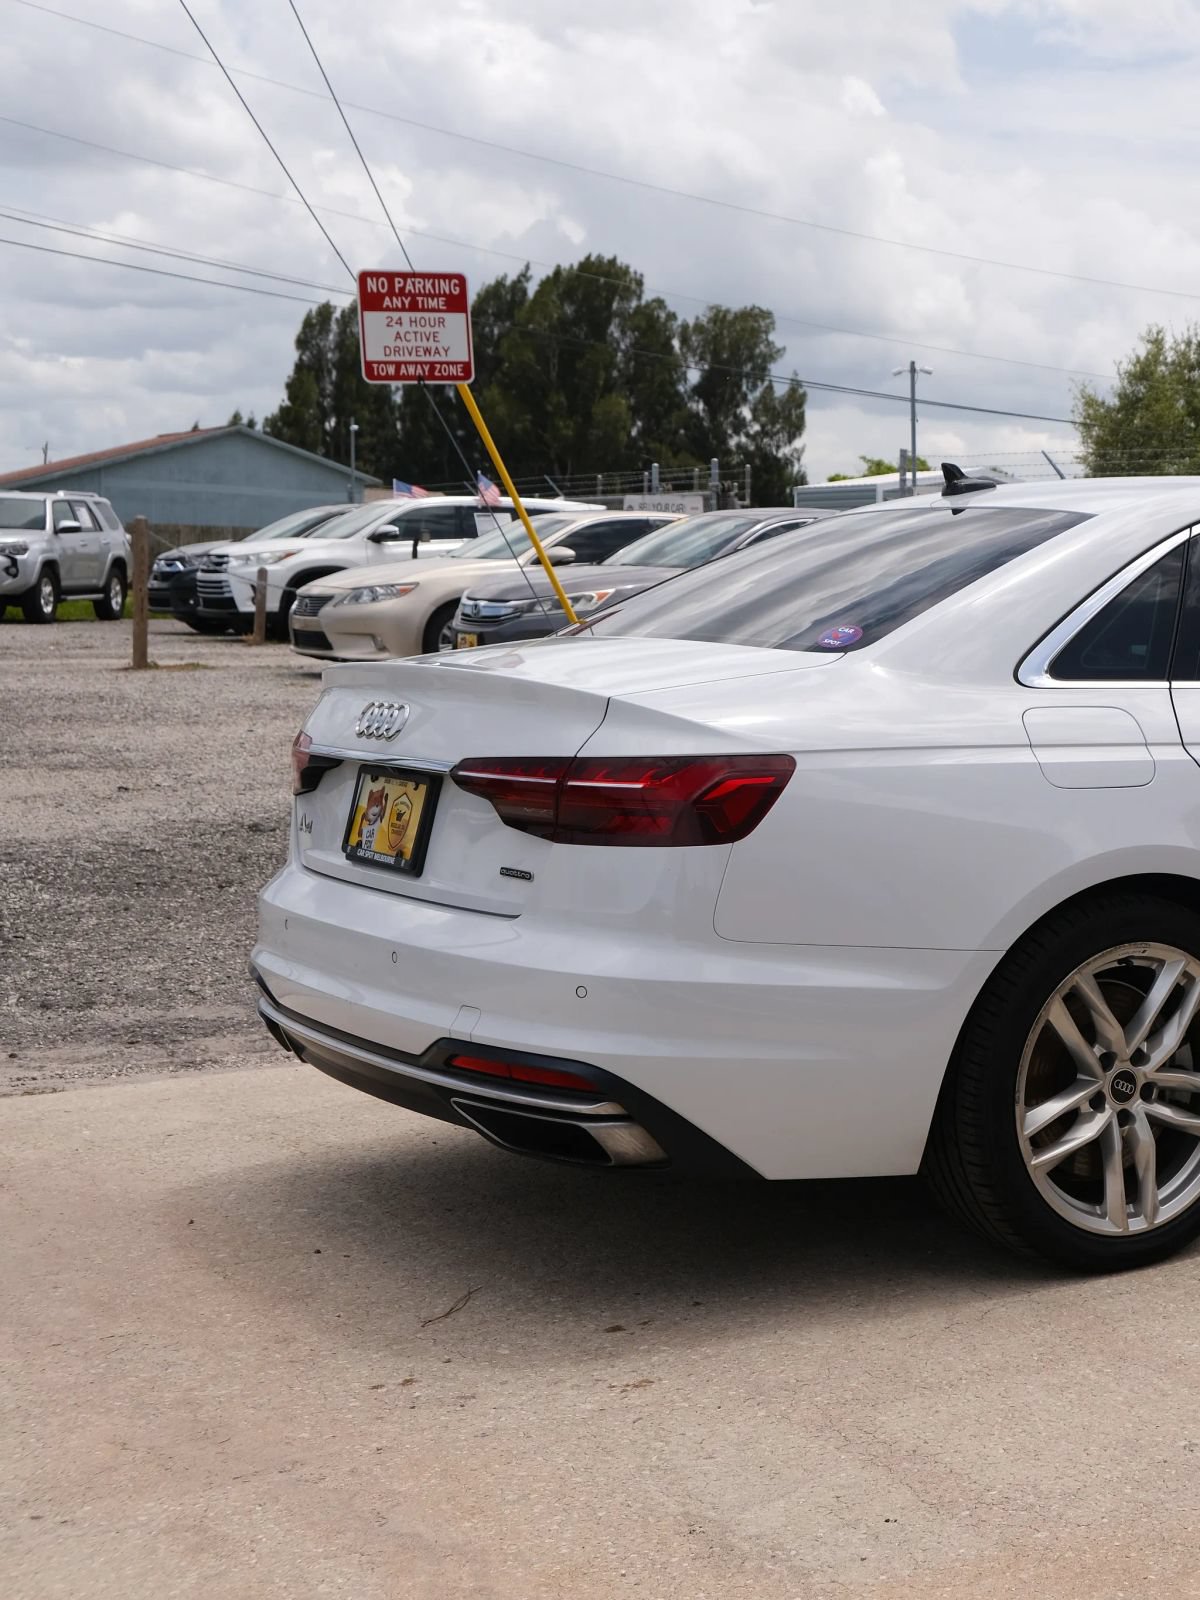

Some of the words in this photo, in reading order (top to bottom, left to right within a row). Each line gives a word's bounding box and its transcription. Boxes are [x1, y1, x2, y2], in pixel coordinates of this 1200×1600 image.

[367, 277, 388, 293] NO
[394, 278, 460, 295] PARKING
[383, 297, 411, 309] ANY
[416, 297, 447, 309] TIME
[385, 316, 403, 327] 24
[409, 316, 446, 328] HOUR
[394, 331, 440, 343] ACTIVE
[383, 345, 450, 357] DRIVEWAY
[372, 364, 396, 376] TOW
[400, 364, 430, 376] AWAY
[434, 364, 464, 376] ZONE
[365, 828, 375, 839] CAR
[500, 869, 530, 880] quattro
